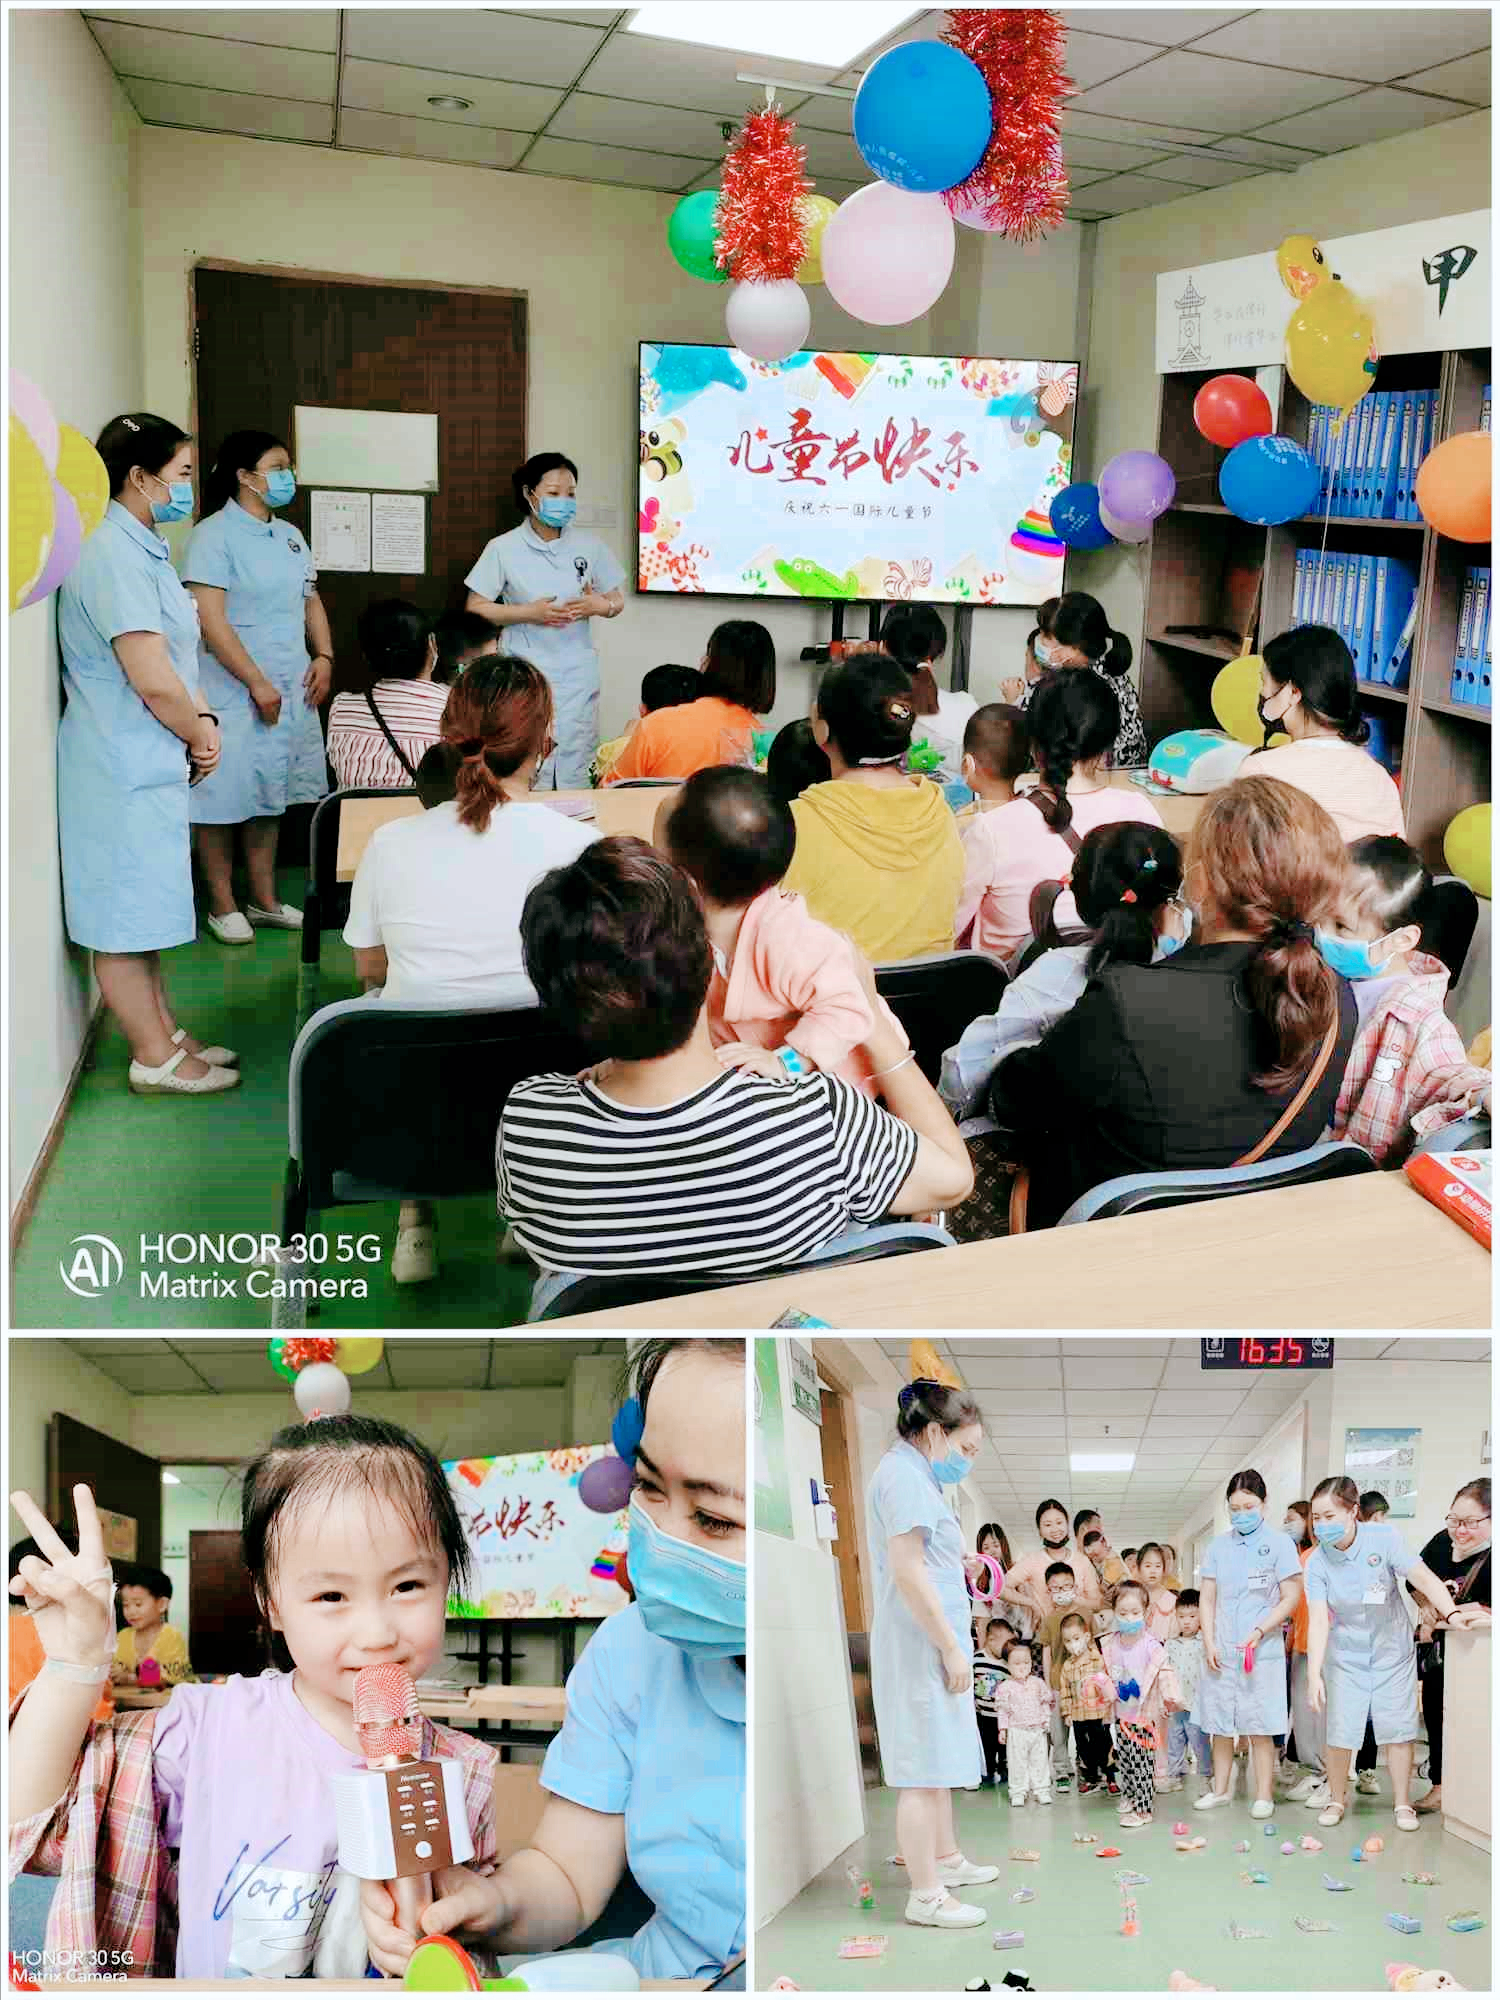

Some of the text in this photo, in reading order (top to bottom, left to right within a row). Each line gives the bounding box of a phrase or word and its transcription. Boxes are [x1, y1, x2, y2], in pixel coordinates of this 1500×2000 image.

[1422, 245, 1478, 320] 甲
[727, 407, 980, 488] 儿童节快乐
[784, 500, 932, 519] 庆祝六一国际儿童节
